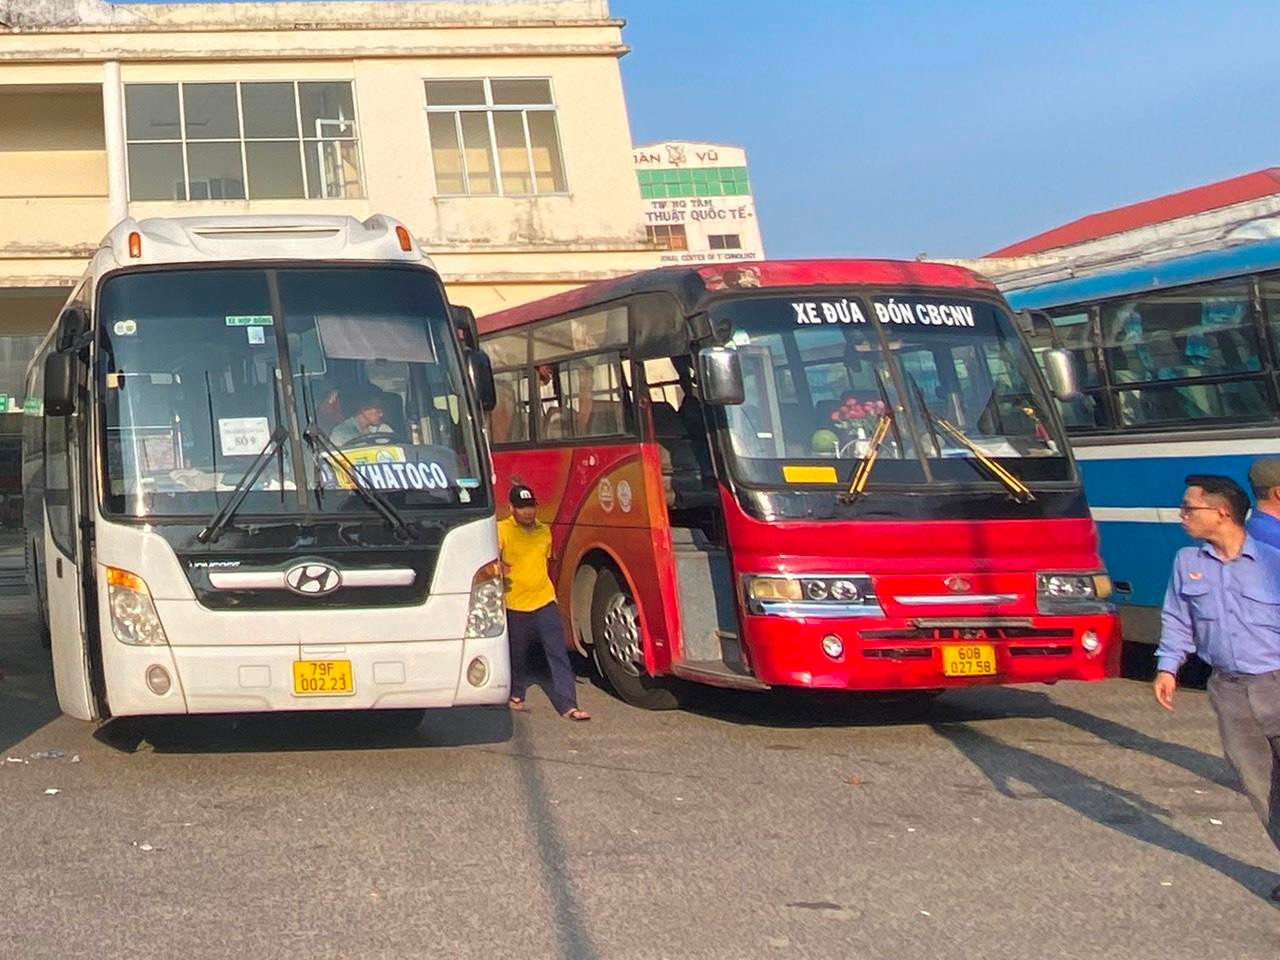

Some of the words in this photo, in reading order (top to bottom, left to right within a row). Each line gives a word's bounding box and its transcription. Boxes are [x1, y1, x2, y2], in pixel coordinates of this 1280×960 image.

[792, 302, 822, 325] XE
[821, 298, 866, 325] ĐƯA
[874, 298, 916, 325] ĐÓN
[916, 304, 976, 327] CBCNV
[355, 462, 448, 490] KHATOCO
[958, 647, 981, 660] 60B
[310, 662, 334, 676] 79F
[301, 677, 346, 691] 002.23
